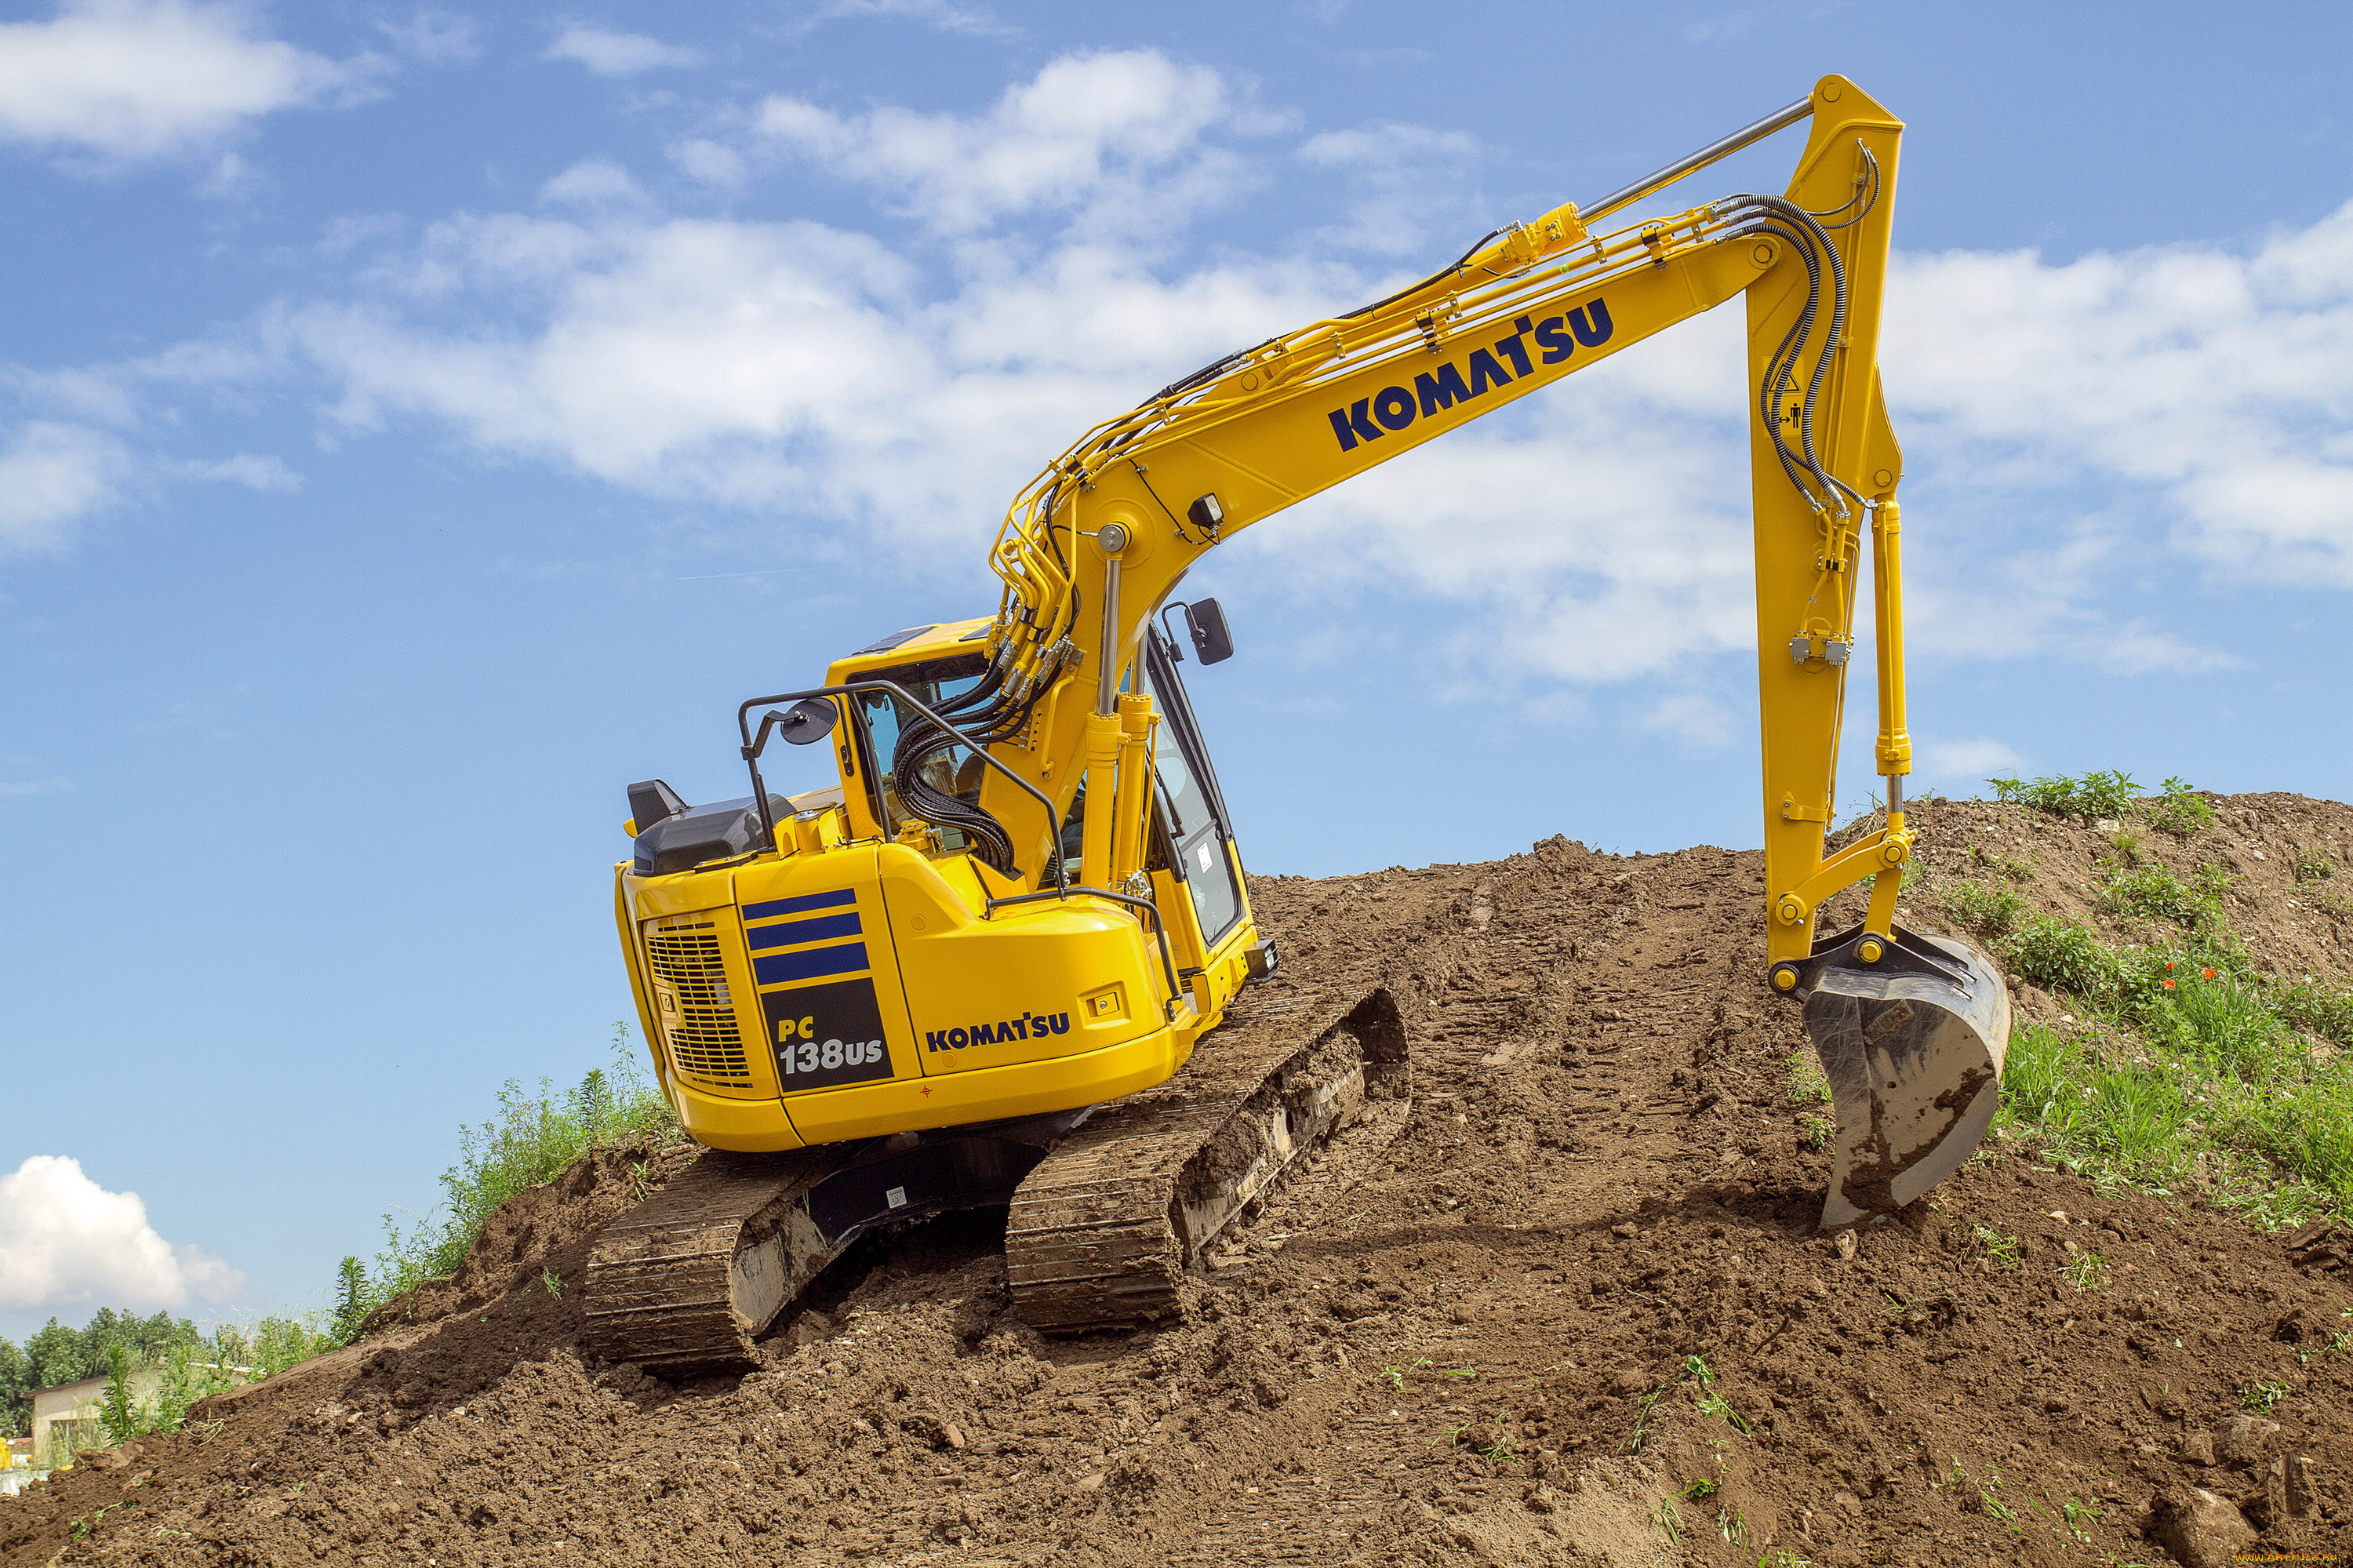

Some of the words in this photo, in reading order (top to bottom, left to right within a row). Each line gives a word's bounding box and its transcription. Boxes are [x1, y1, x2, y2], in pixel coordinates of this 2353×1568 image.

[1328, 297, 1613, 452] KOMATSU
[779, 1016, 813, 1042] PC
[926, 1012, 1070, 1053] KOMATSU
